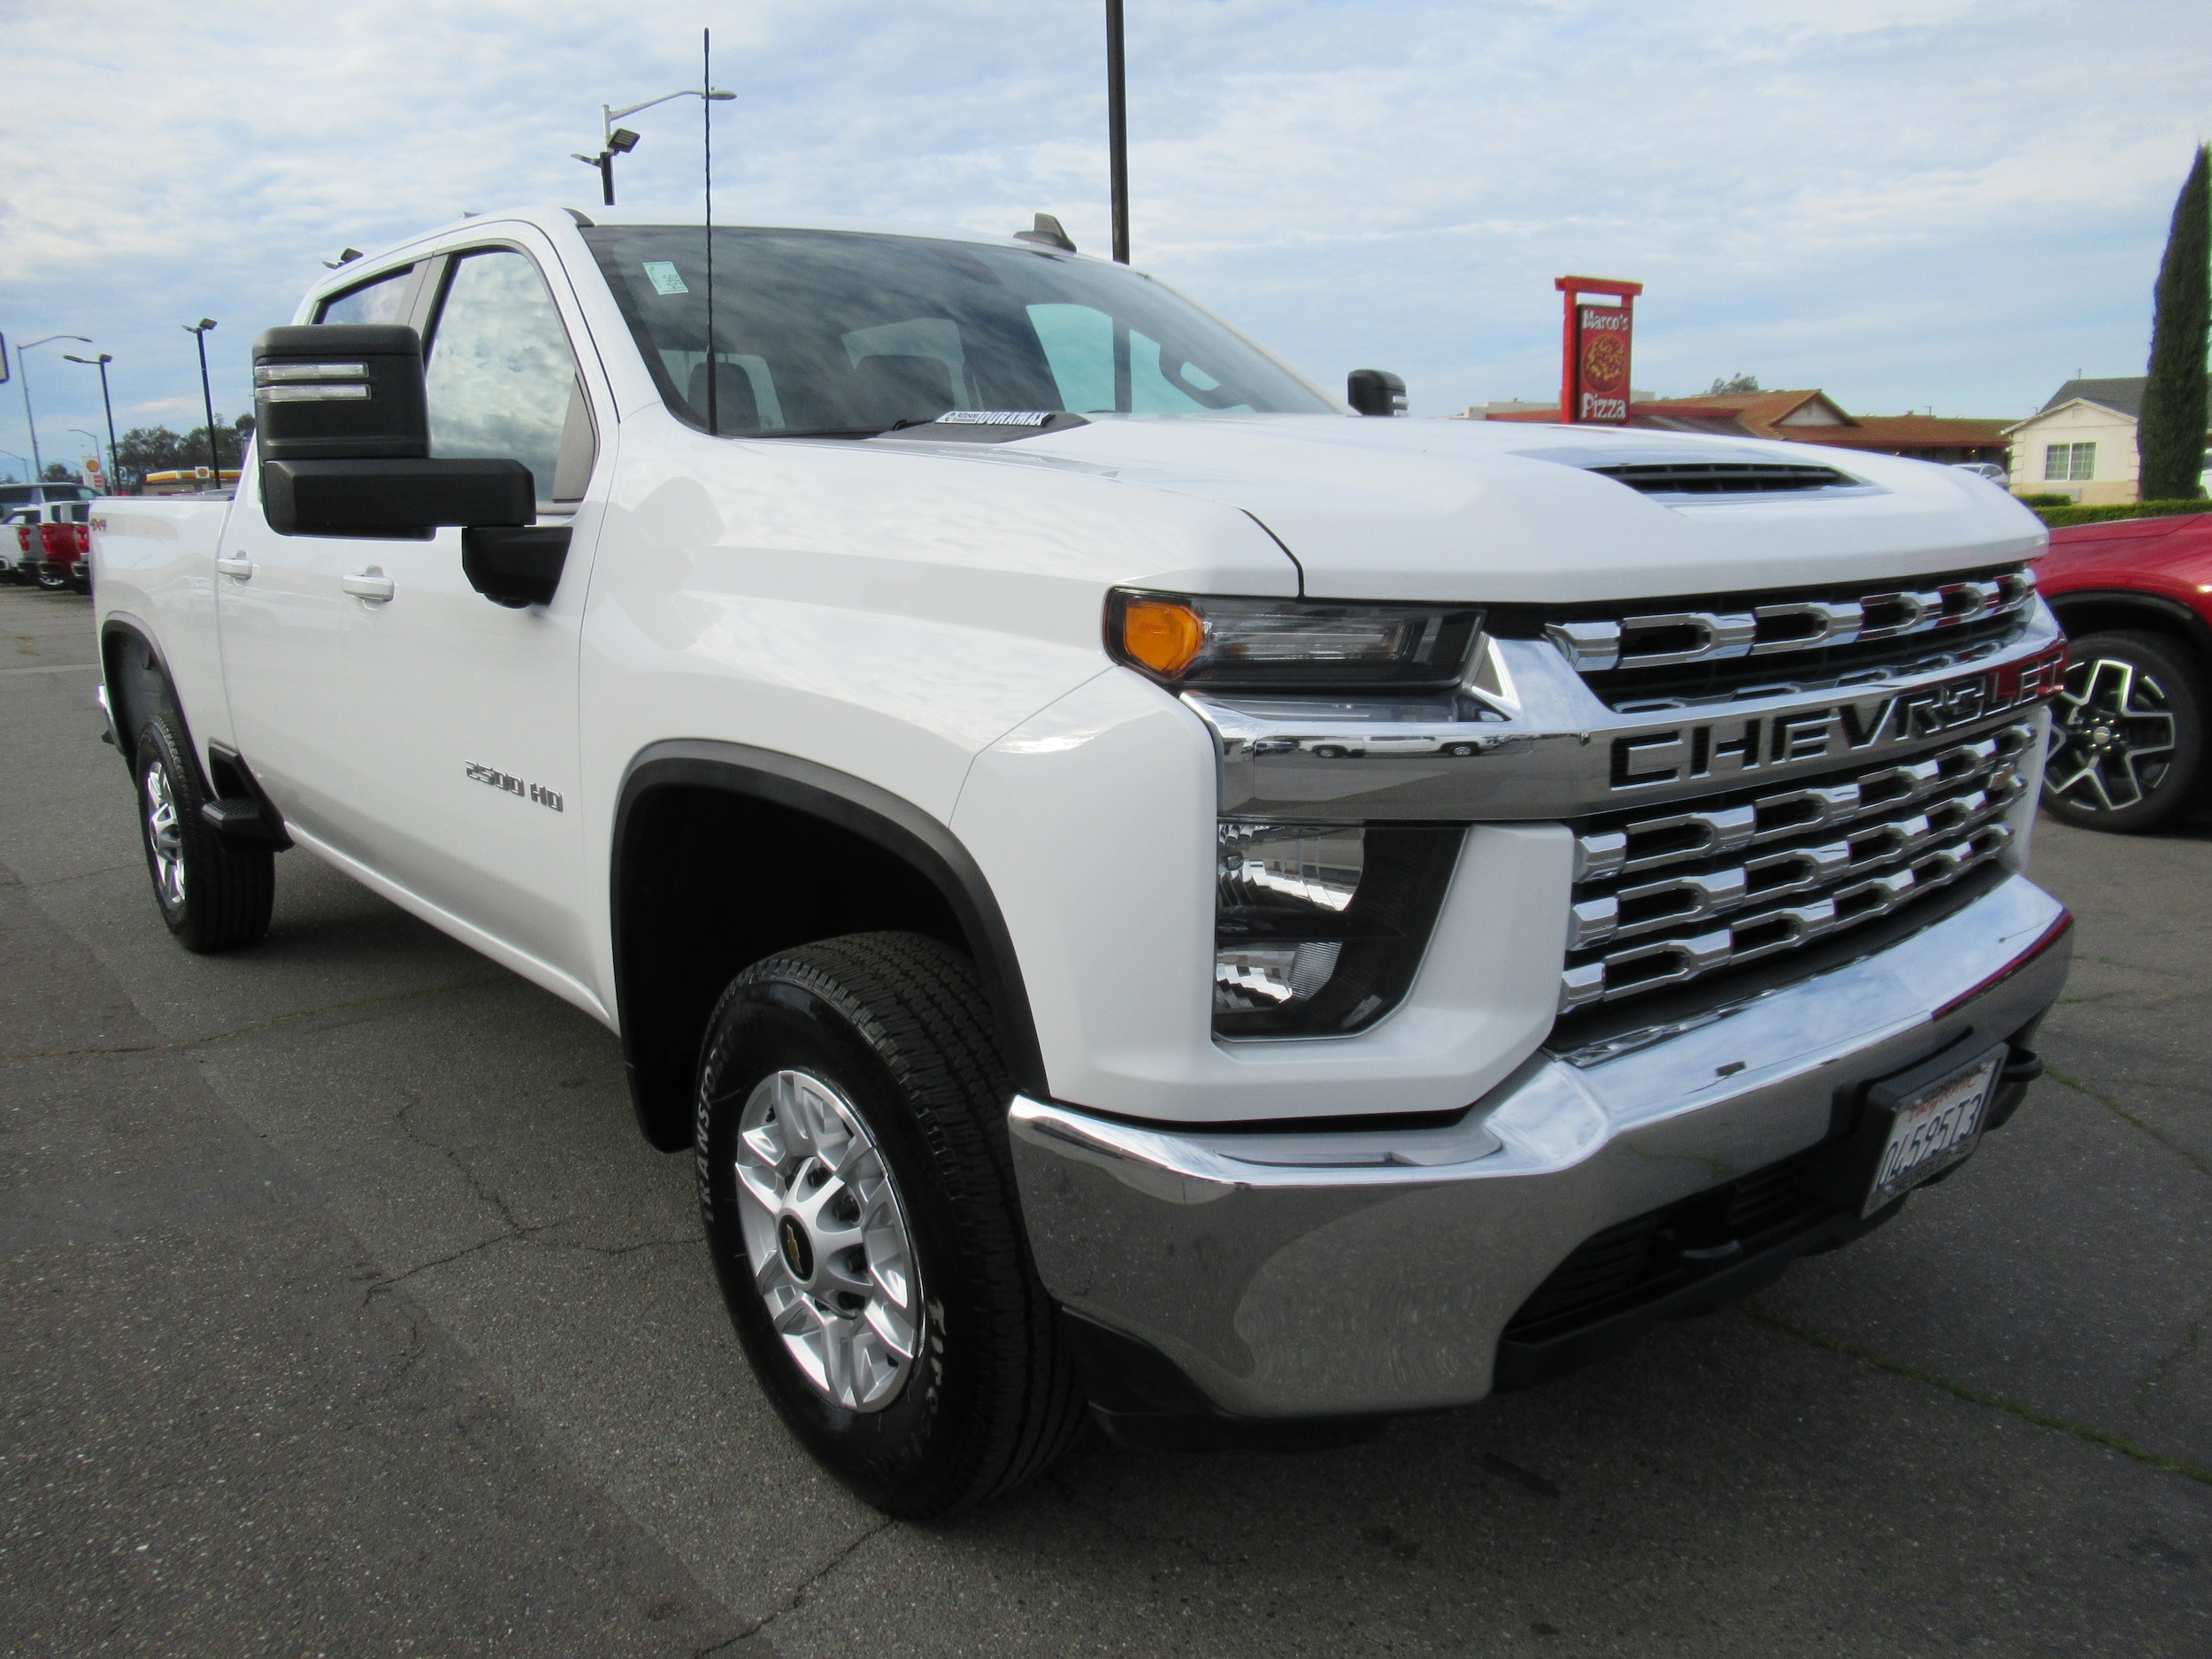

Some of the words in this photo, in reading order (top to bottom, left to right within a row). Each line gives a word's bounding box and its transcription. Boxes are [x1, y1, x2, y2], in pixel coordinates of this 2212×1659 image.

[1582, 310, 1629, 332] Marco's
[977, 411, 1052, 426] DURAMAX
[1582, 392, 1626, 419] Pizza
[1609, 651, 2063, 791] CHEVROLET
[465, 759, 525, 796] 2500
[530, 781, 564, 812] HD
[1877, 1093, 1983, 1190] 04595T3
